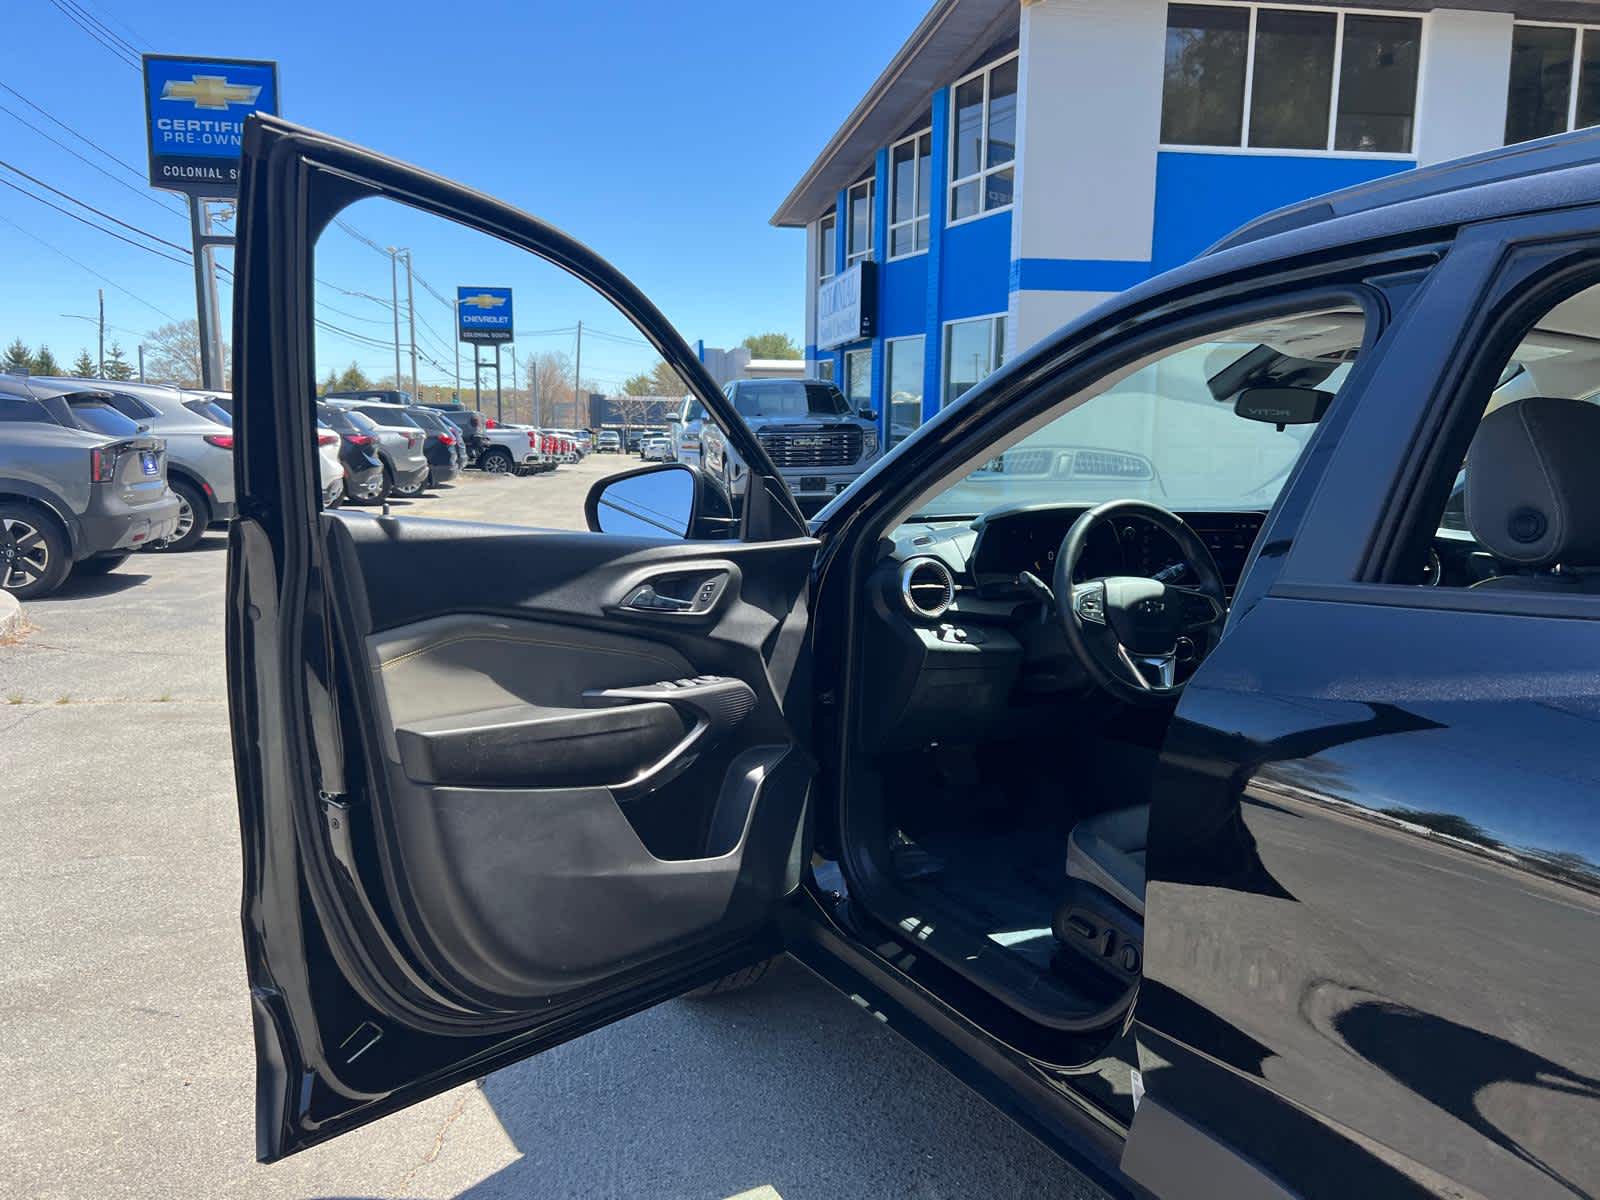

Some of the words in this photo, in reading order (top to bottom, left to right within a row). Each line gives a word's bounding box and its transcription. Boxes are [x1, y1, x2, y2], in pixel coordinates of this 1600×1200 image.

[163, 131, 241, 146] PRE-OWN
[163, 165, 223, 178] COLONIAL
[229, 168, 240, 180] S
[463, 315, 508, 324] CHEVROLET
